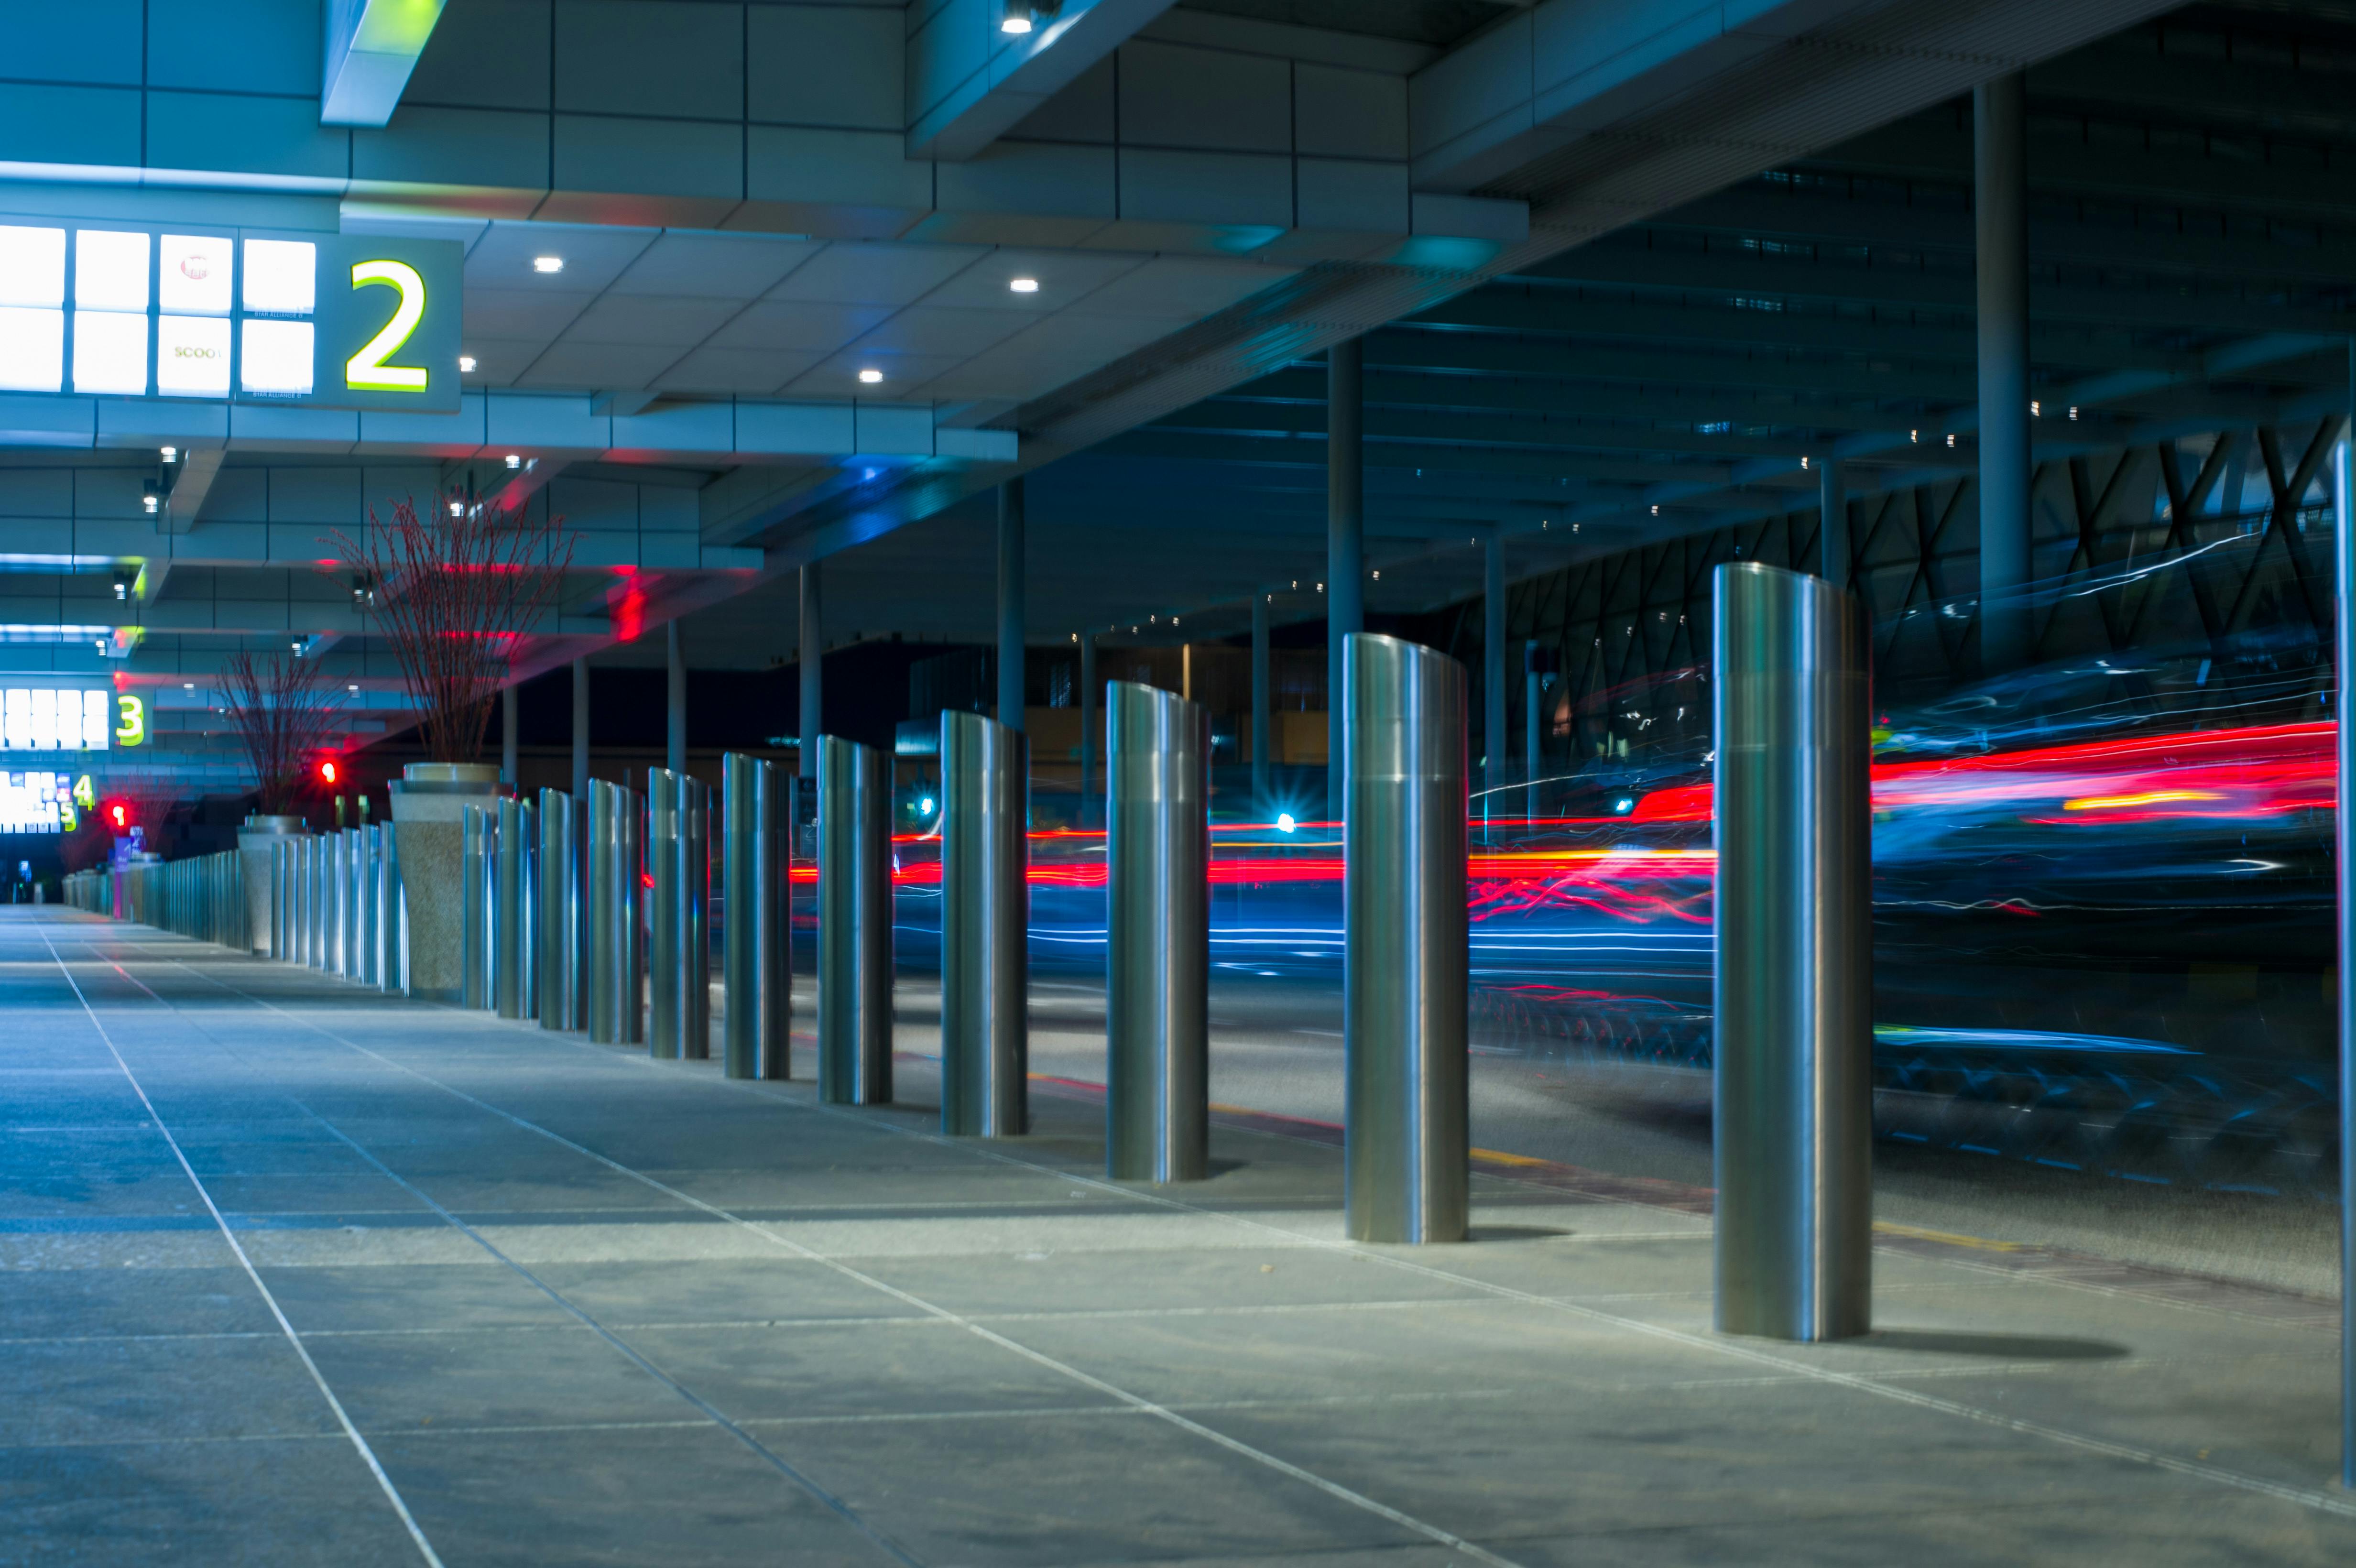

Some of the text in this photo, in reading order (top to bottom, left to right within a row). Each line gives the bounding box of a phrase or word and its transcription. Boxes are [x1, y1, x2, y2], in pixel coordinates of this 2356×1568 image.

[346, 260, 429, 392] 2
[116, 696, 143, 744] 3
[73, 775, 94, 808] 4
[61, 802, 76, 830] 5
